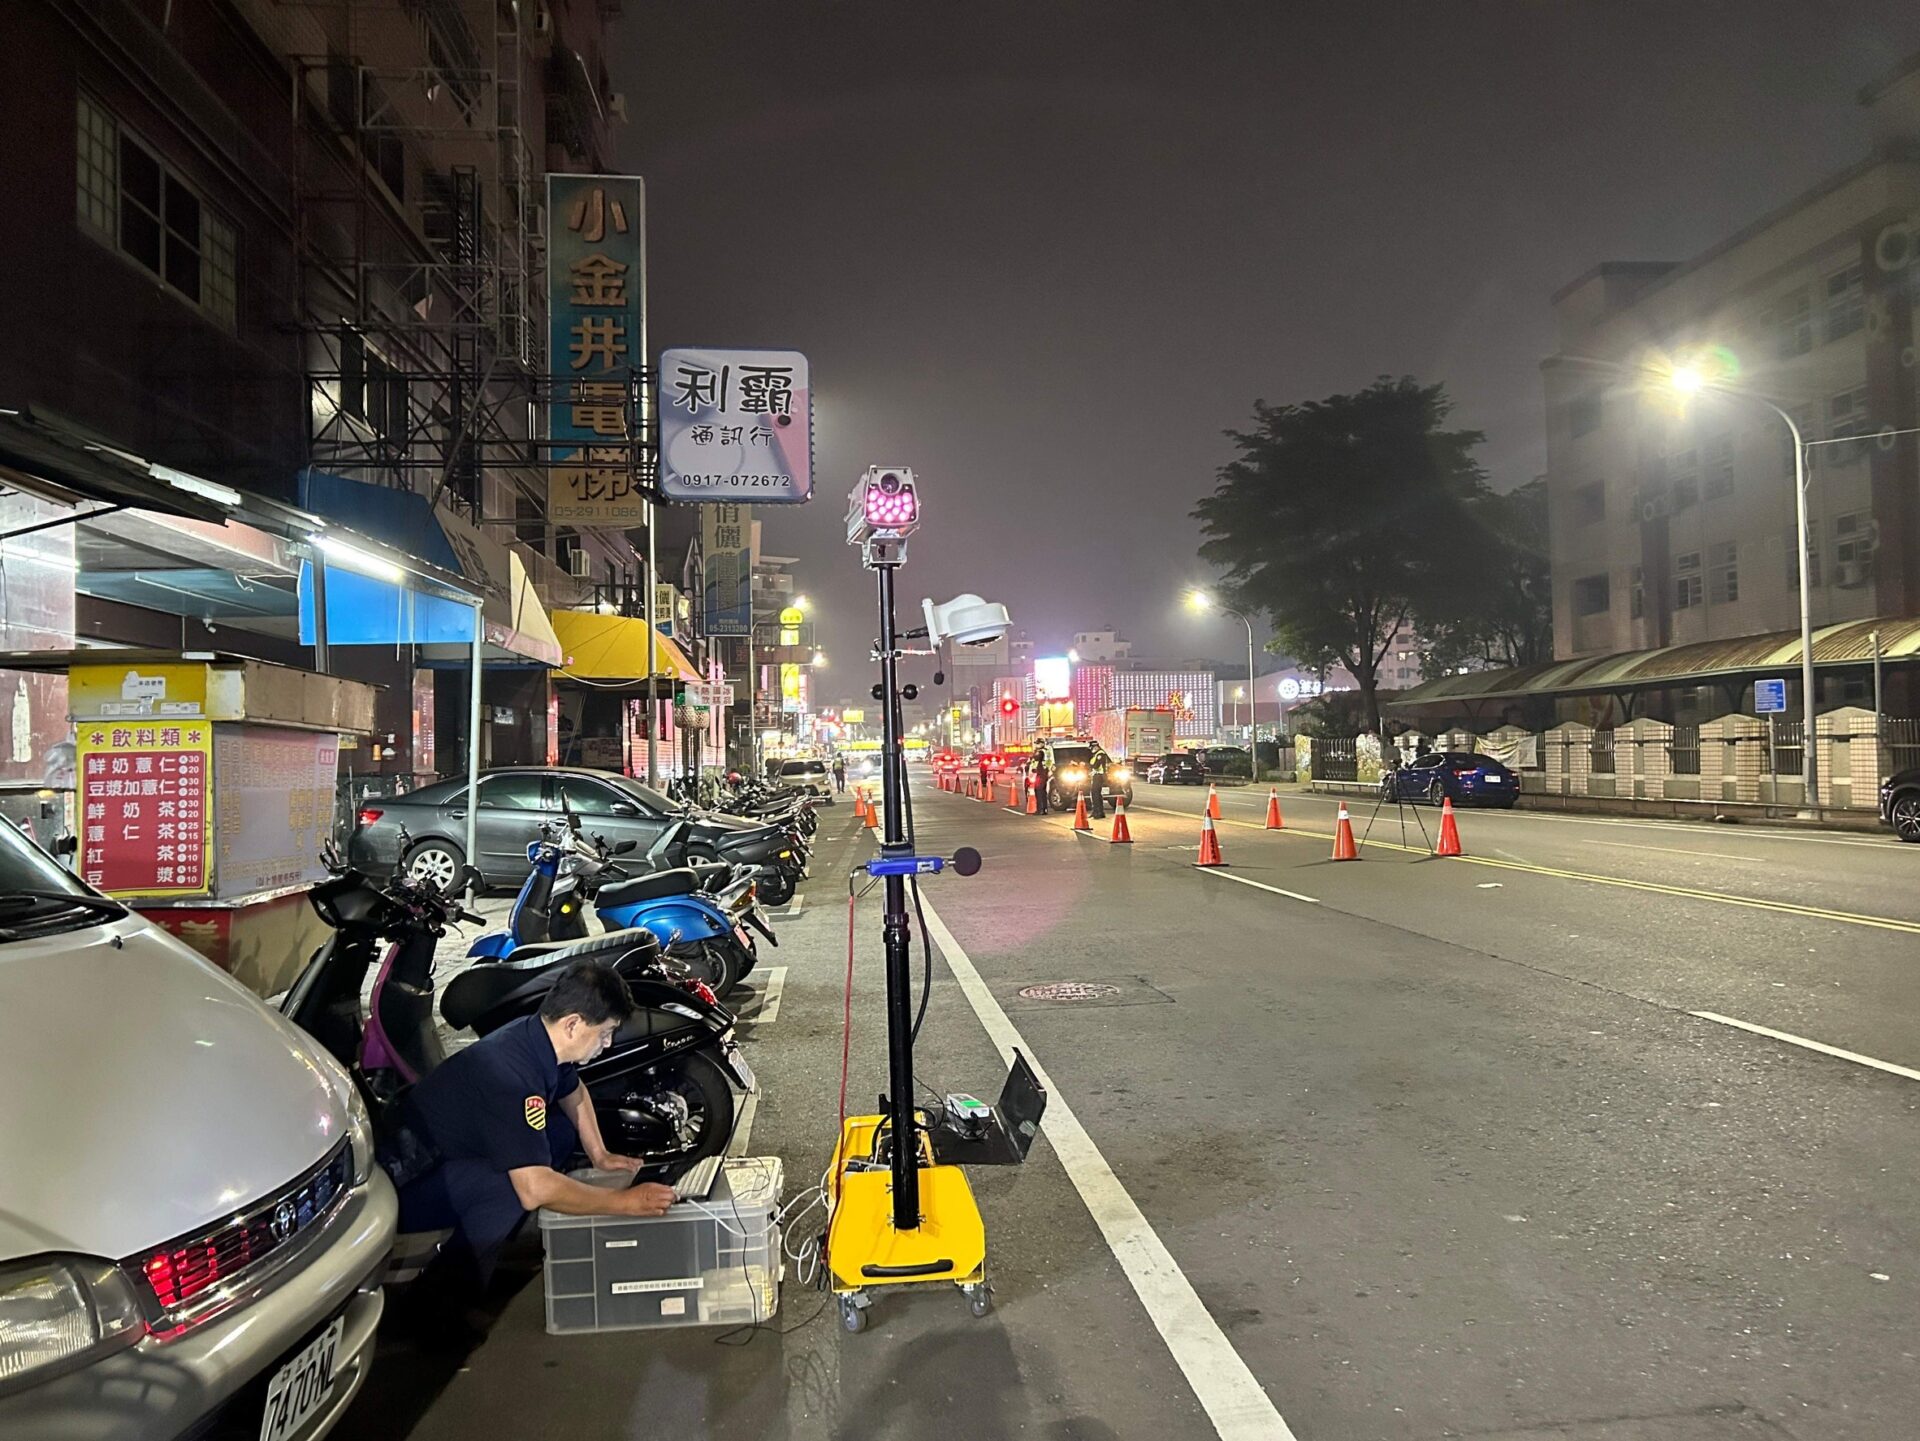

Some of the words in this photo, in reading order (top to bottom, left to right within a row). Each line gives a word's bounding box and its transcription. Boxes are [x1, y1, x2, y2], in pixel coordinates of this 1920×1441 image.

[567, 189, 629, 501] 小金井電梯
[673, 364, 794, 414] 利霸
[691, 425, 774, 447] 通訊行
[683, 474, 790, 487] 0917-072672
[112, 727, 181, 748] 飲料類
[87, 756, 177, 775] 鮮奶薏仁
[188, 755, 199, 763] 30
[188, 766, 199, 774] 20
[87, 778, 177, 797] 豆漿加薏仁
[188, 777, 199, 785] 30
[188, 788, 199, 796] 20
[86, 800, 176, 820] 鮮奶茶
[188, 800, 199, 808] 30
[188, 810, 199, 818] 20
[86, 822, 176, 842] 薏仁茶
[188, 822, 199, 830] 25
[188, 832, 199, 840] 15
[86, 844, 175, 864] 紅茶
[188, 844, 198, 852] 15
[187, 854, 198, 862] 10
[86, 866, 174, 886] 豆漿
[186, 875, 197, 883] 10
[268, 1340, 335, 1441] 7470-NL
